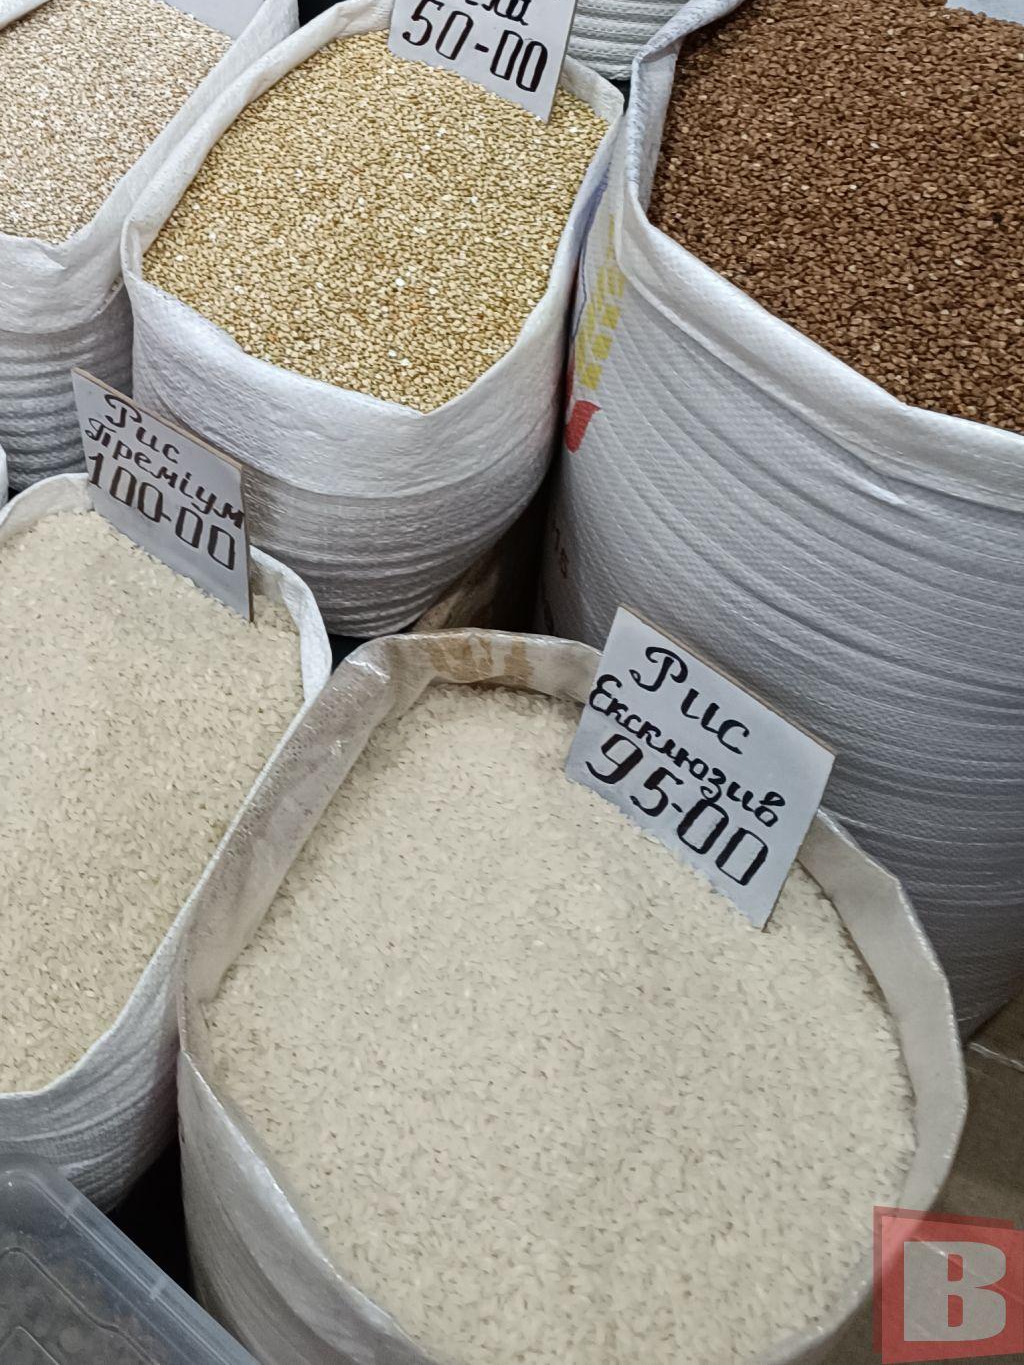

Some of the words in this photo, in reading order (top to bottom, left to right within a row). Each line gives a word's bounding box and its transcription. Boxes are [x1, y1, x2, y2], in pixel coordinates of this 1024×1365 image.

[104, 394, 180, 464] Рис
[87, 452, 236, 571] 100-00
[588, 673, 786, 828] Ексклюзив
[629, 646, 750, 755] Рис
[584, 733, 769, 886] 95-00
